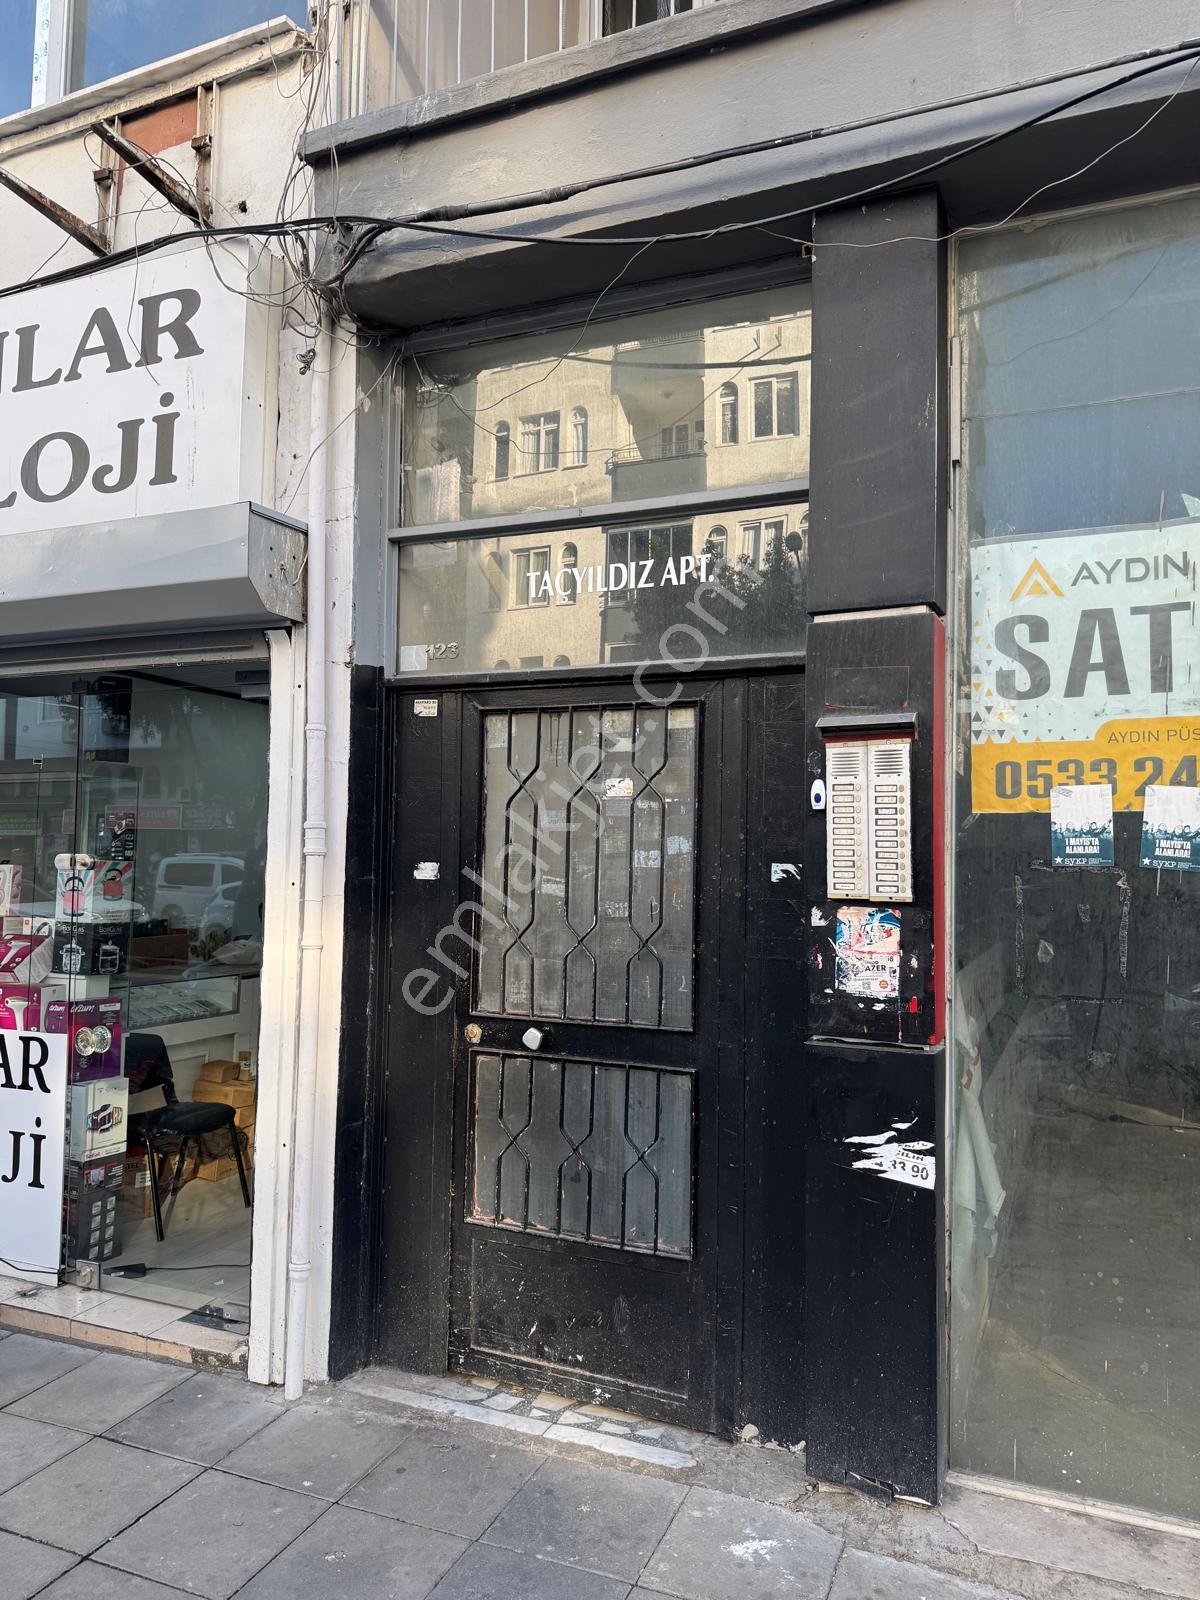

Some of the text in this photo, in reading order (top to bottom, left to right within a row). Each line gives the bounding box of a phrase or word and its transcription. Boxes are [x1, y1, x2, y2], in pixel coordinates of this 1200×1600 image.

[0, 288, 204, 393] LAR
[527, 554, 714, 604] TAÇYILDIZ APT.
[1070, 551, 1190, 587] AYDIN
[426, 642, 460, 660] 123
[994, 601, 1191, 700] SAT
[1108, 730, 1160, 744] AYDIN
